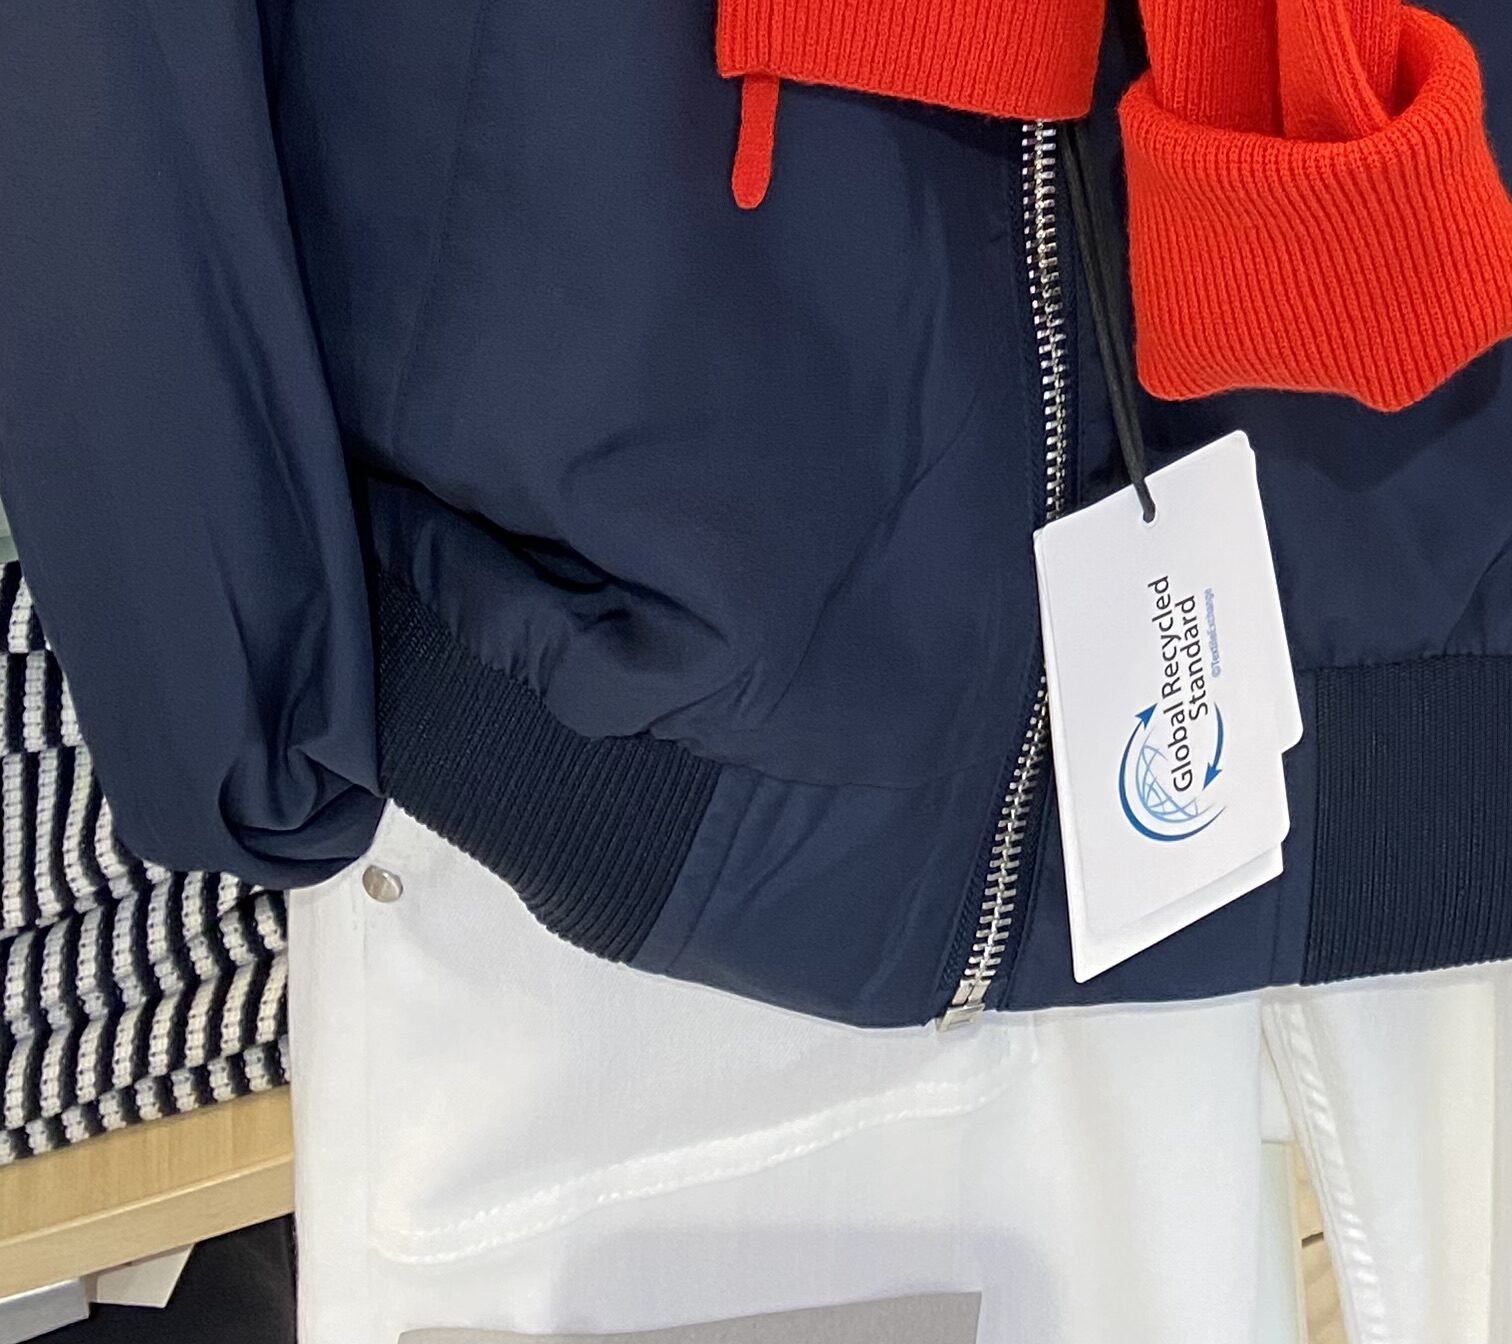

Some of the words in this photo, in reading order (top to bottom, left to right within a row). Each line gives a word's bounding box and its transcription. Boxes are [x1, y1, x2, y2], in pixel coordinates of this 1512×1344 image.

[1148, 575, 1183, 700] Recycled
[1175, 595, 1209, 721] Standard
[1162, 700, 1194, 792] Global
